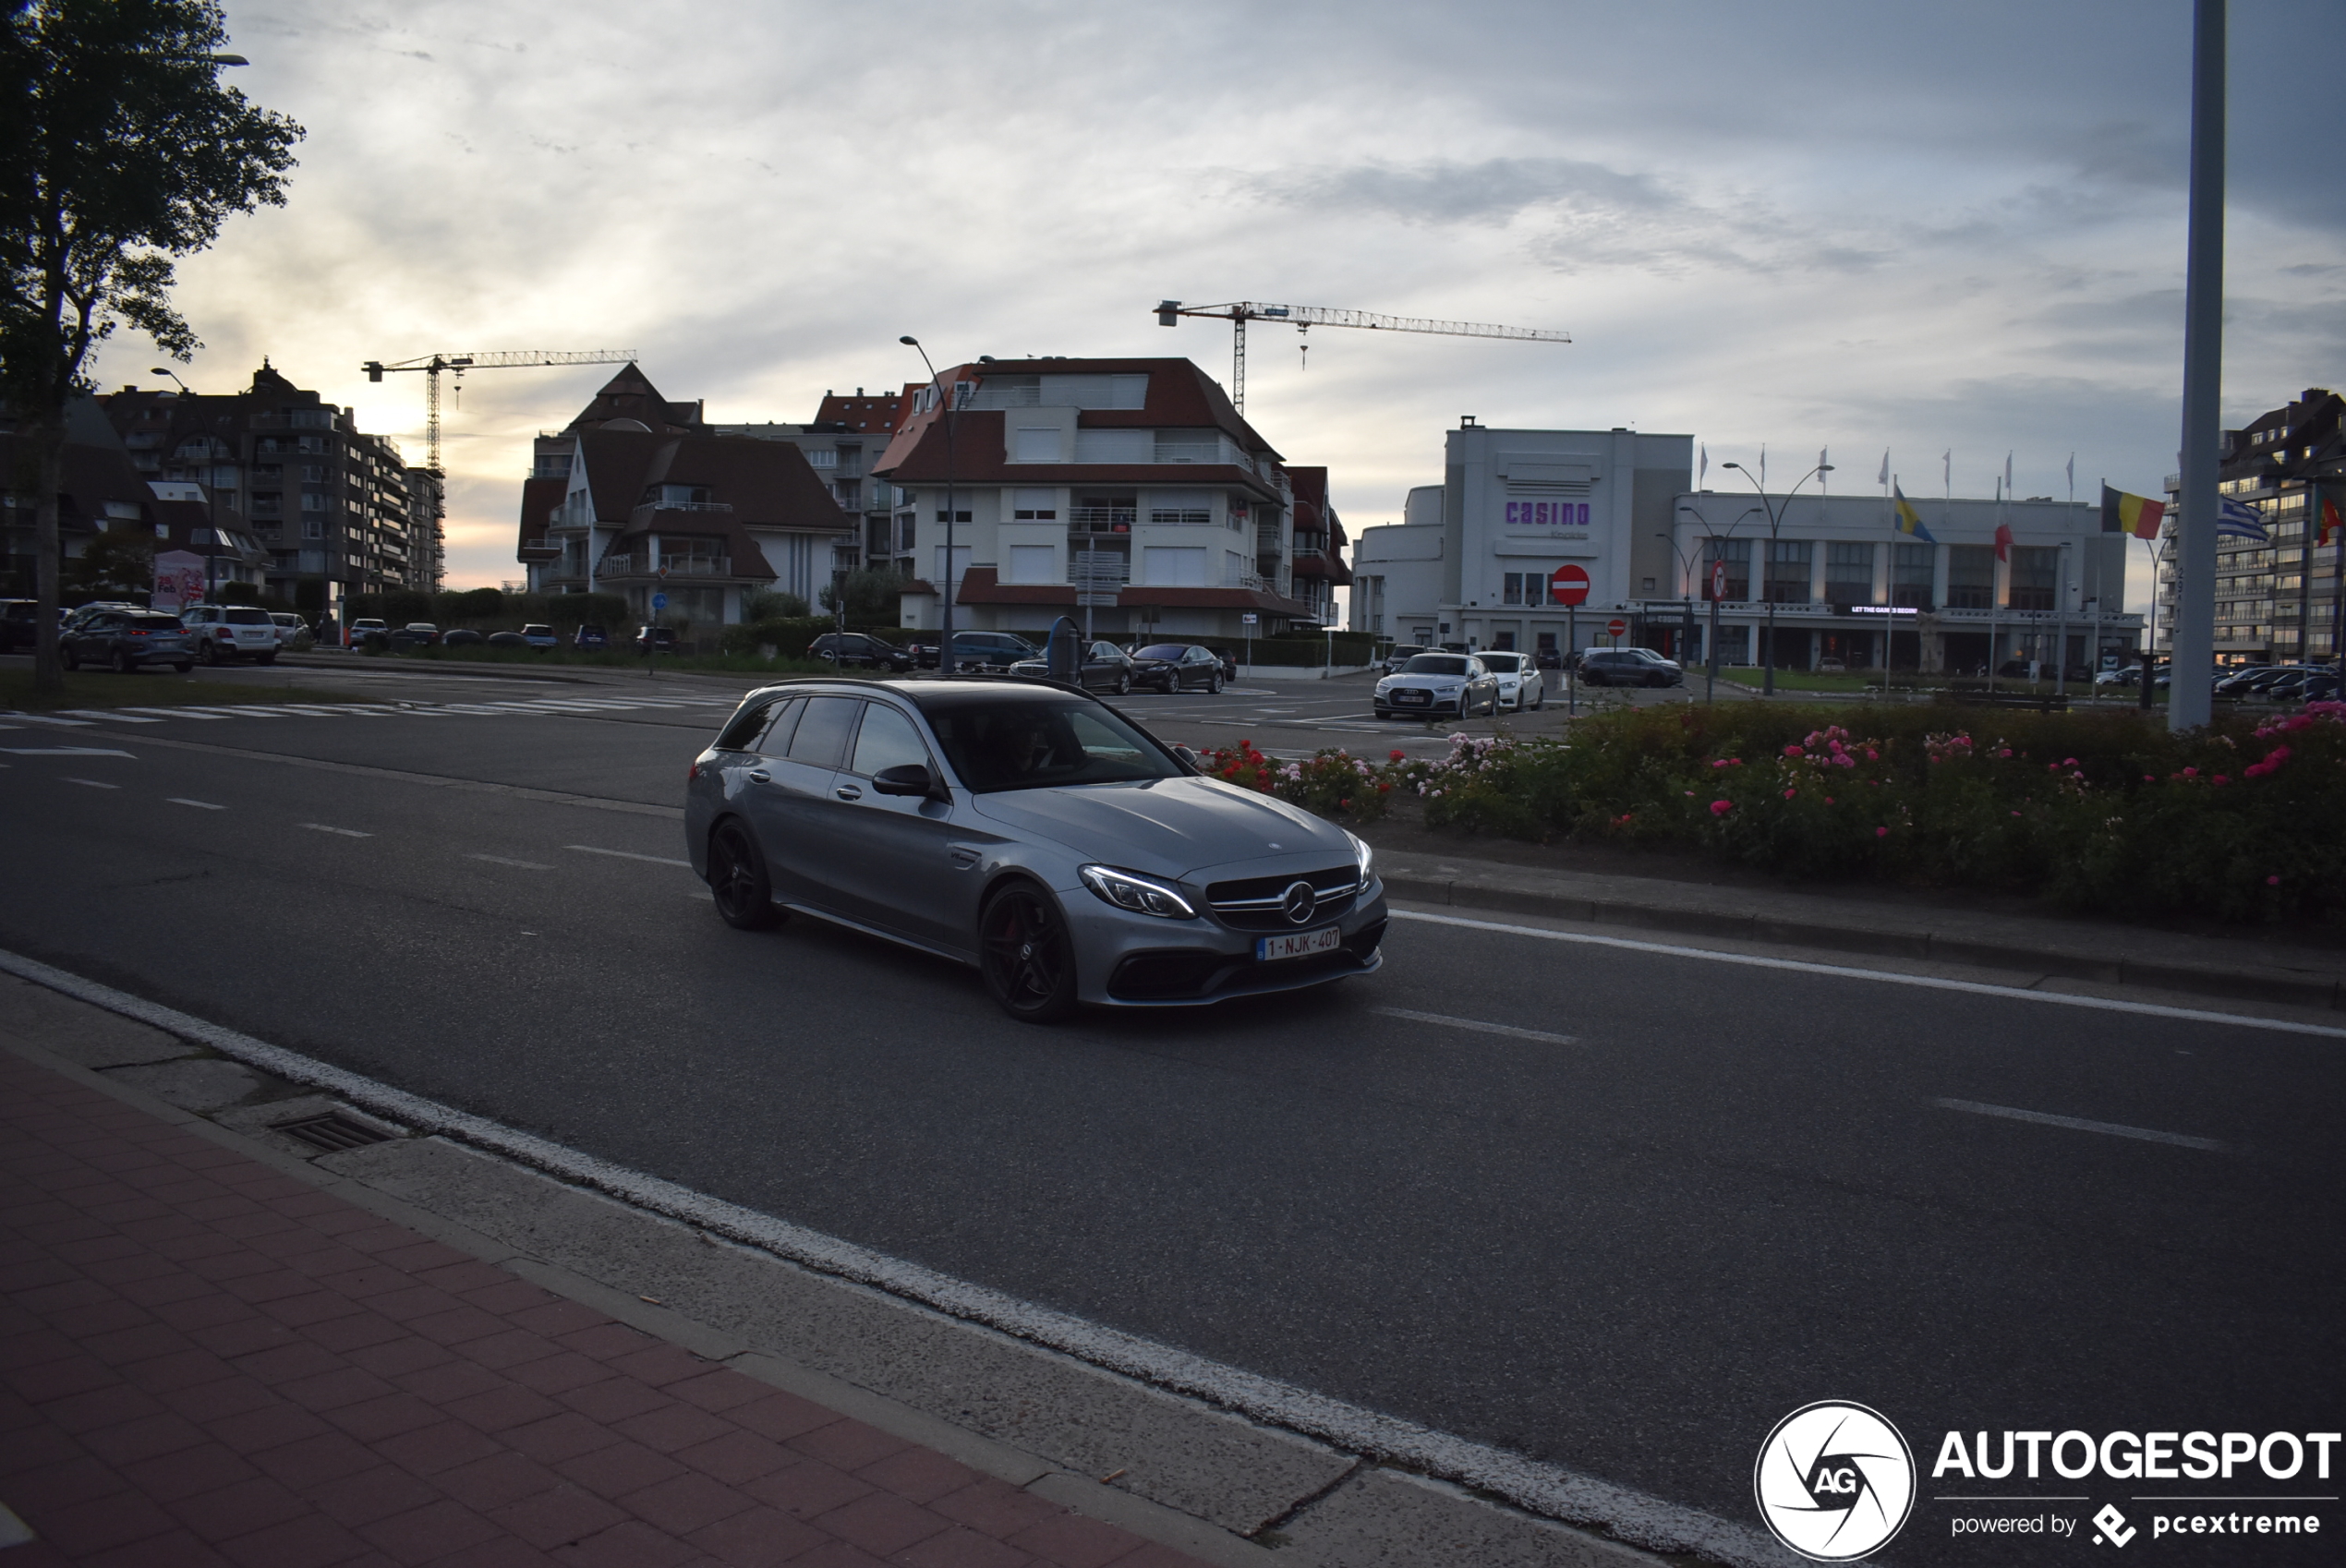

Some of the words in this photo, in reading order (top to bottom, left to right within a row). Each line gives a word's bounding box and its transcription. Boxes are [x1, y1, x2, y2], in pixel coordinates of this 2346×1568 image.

[1506, 502, 1589, 525] casino
[158, 585, 176, 593] Feb
[1269, 929, 1338, 956] 1-NJK-407
